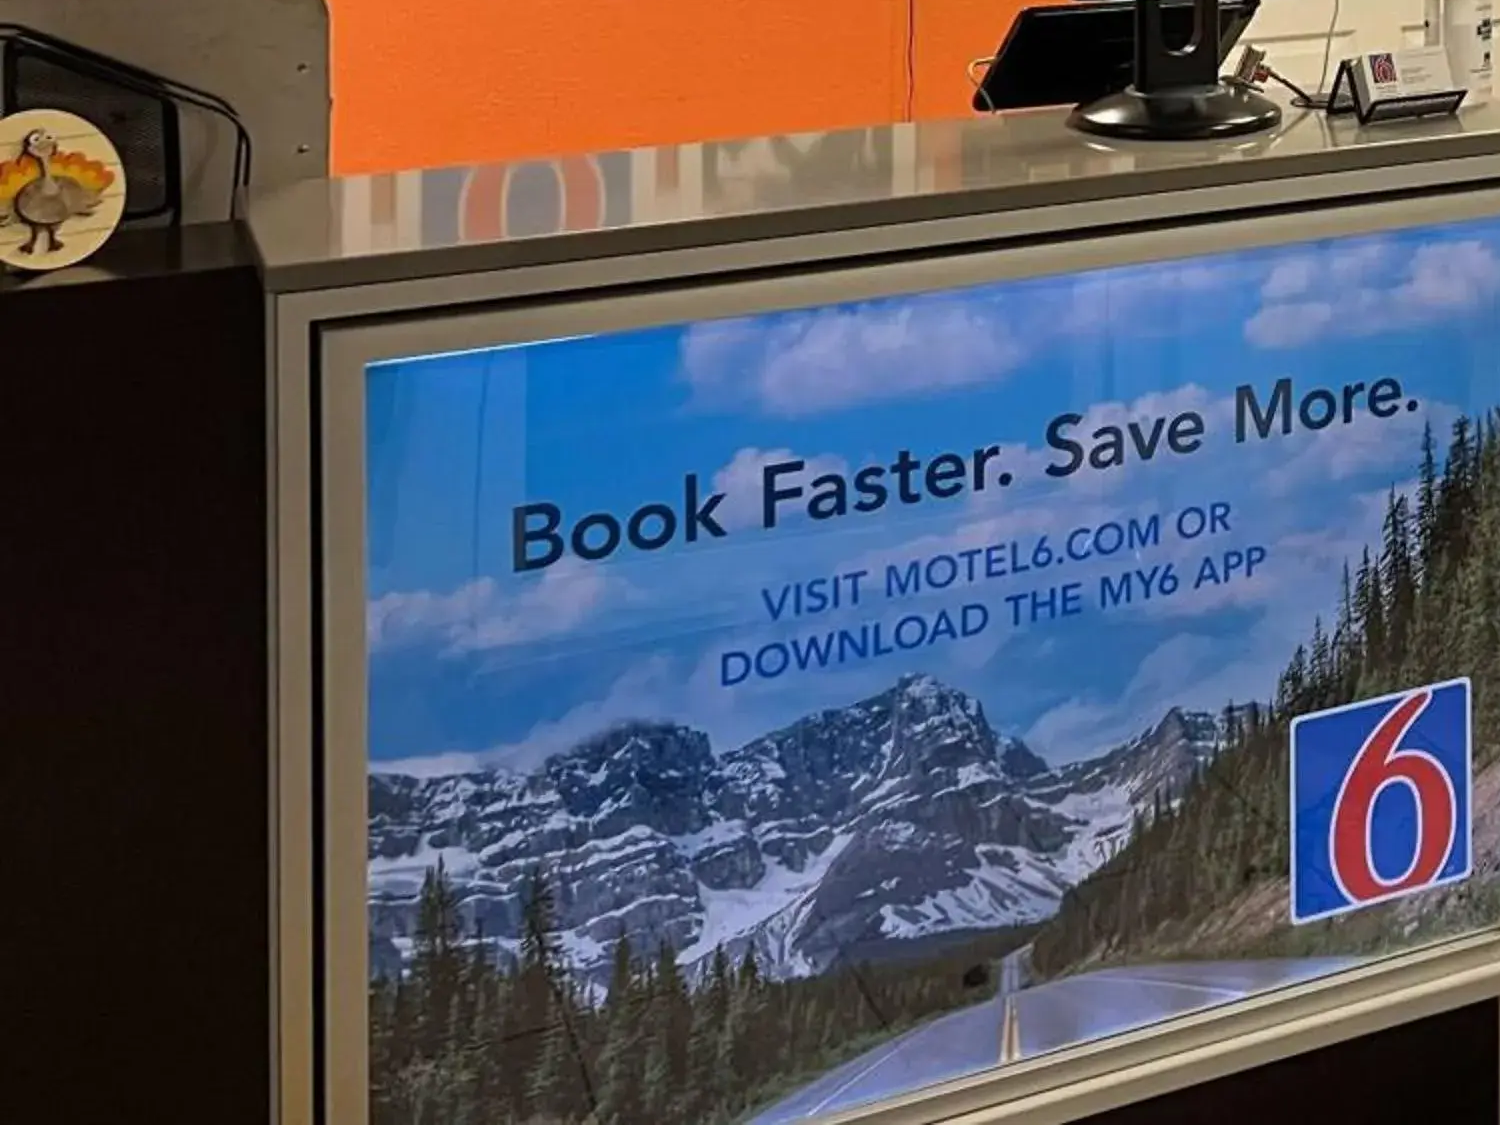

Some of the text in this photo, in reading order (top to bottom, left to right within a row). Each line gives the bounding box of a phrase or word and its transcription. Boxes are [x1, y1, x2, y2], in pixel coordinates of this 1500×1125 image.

[513, 377, 1418, 572] Book Faster. Save More.
[721, 546, 1267, 687] DOWNLOAD THE MY6 APP
[761, 502, 1231, 622] VISIT MOTEL6.COM OR
[1328, 686, 1457, 906] 6
